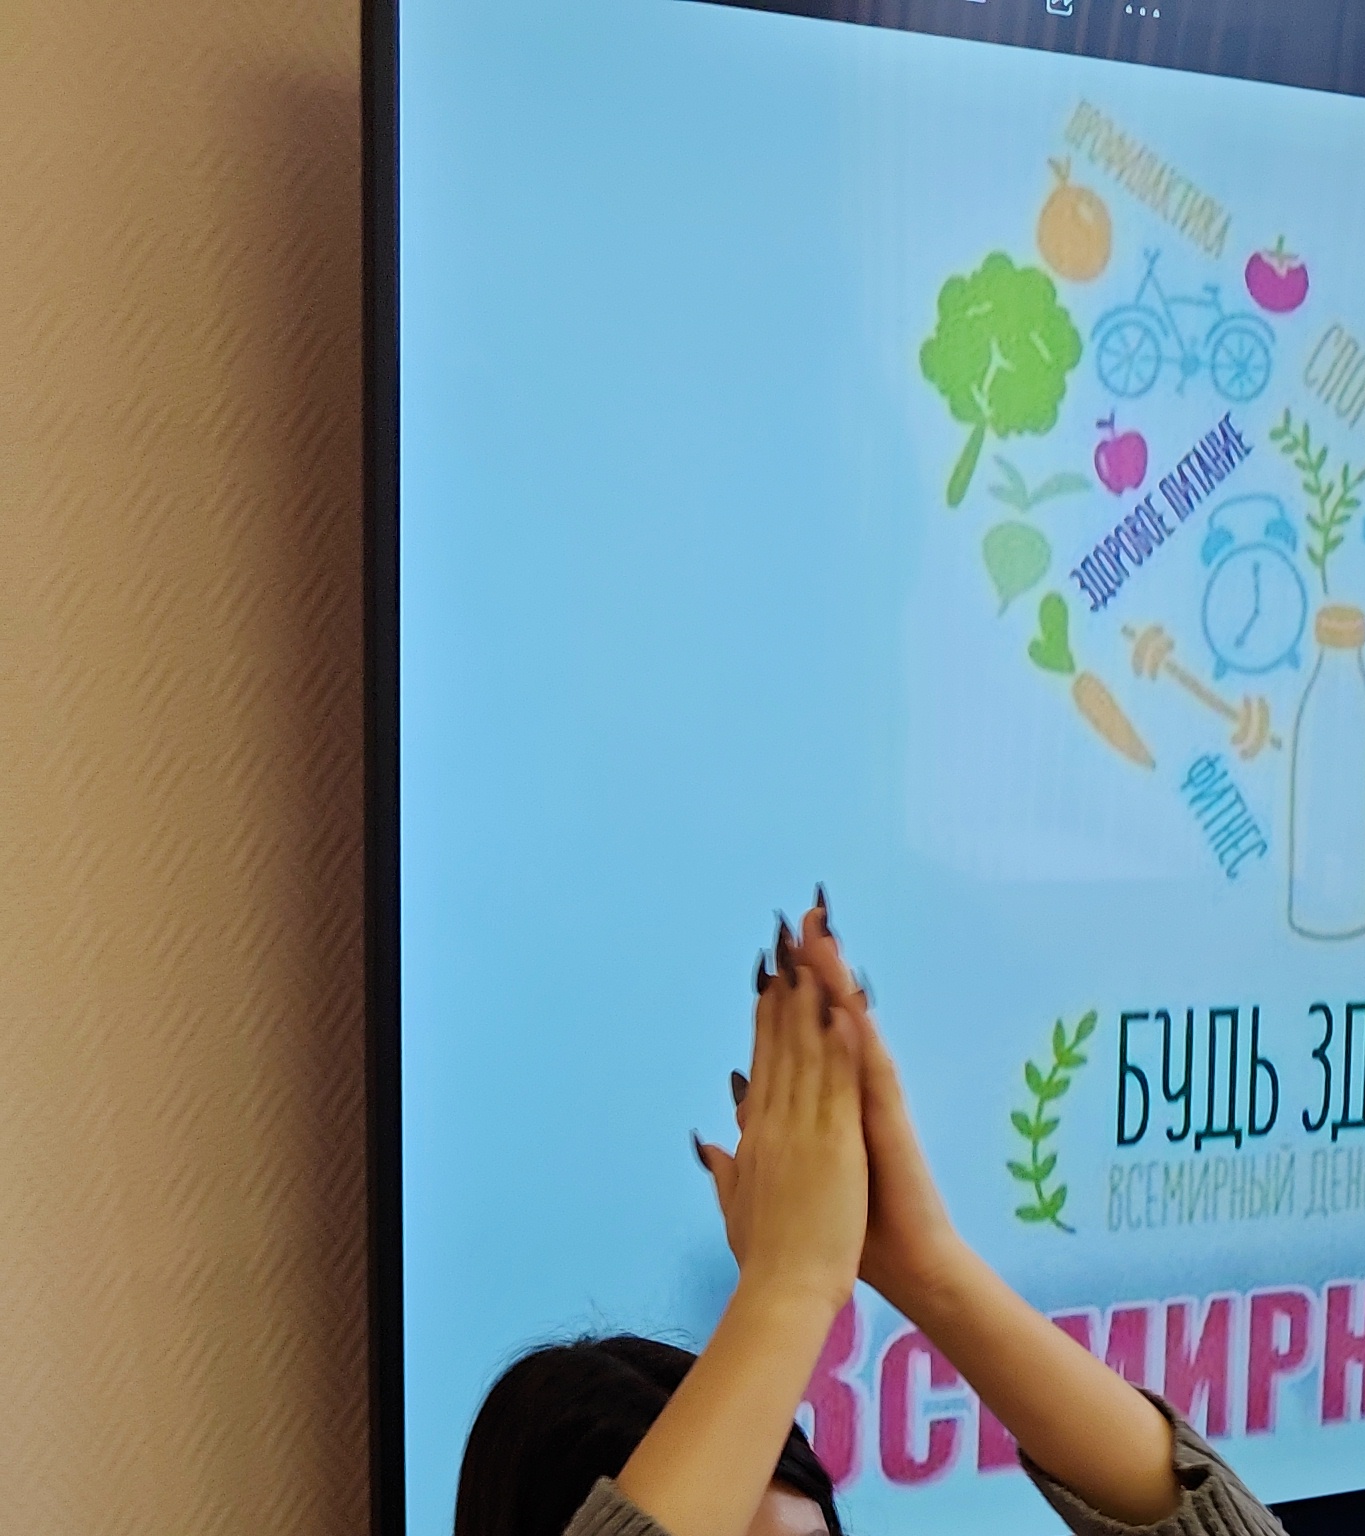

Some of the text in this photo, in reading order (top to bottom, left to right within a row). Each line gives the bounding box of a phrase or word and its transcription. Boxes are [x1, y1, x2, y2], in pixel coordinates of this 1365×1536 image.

[1070, 410, 1254, 612] ЗДОРОВОЕ ПИТАНИЕ
[1180, 752, 1269, 880] ФИТНЕС
[1115, 1006, 1280, 1151] БУДЬ
[1107, 1144, 1295, 1232] ВСЕМИРНЫЙ
